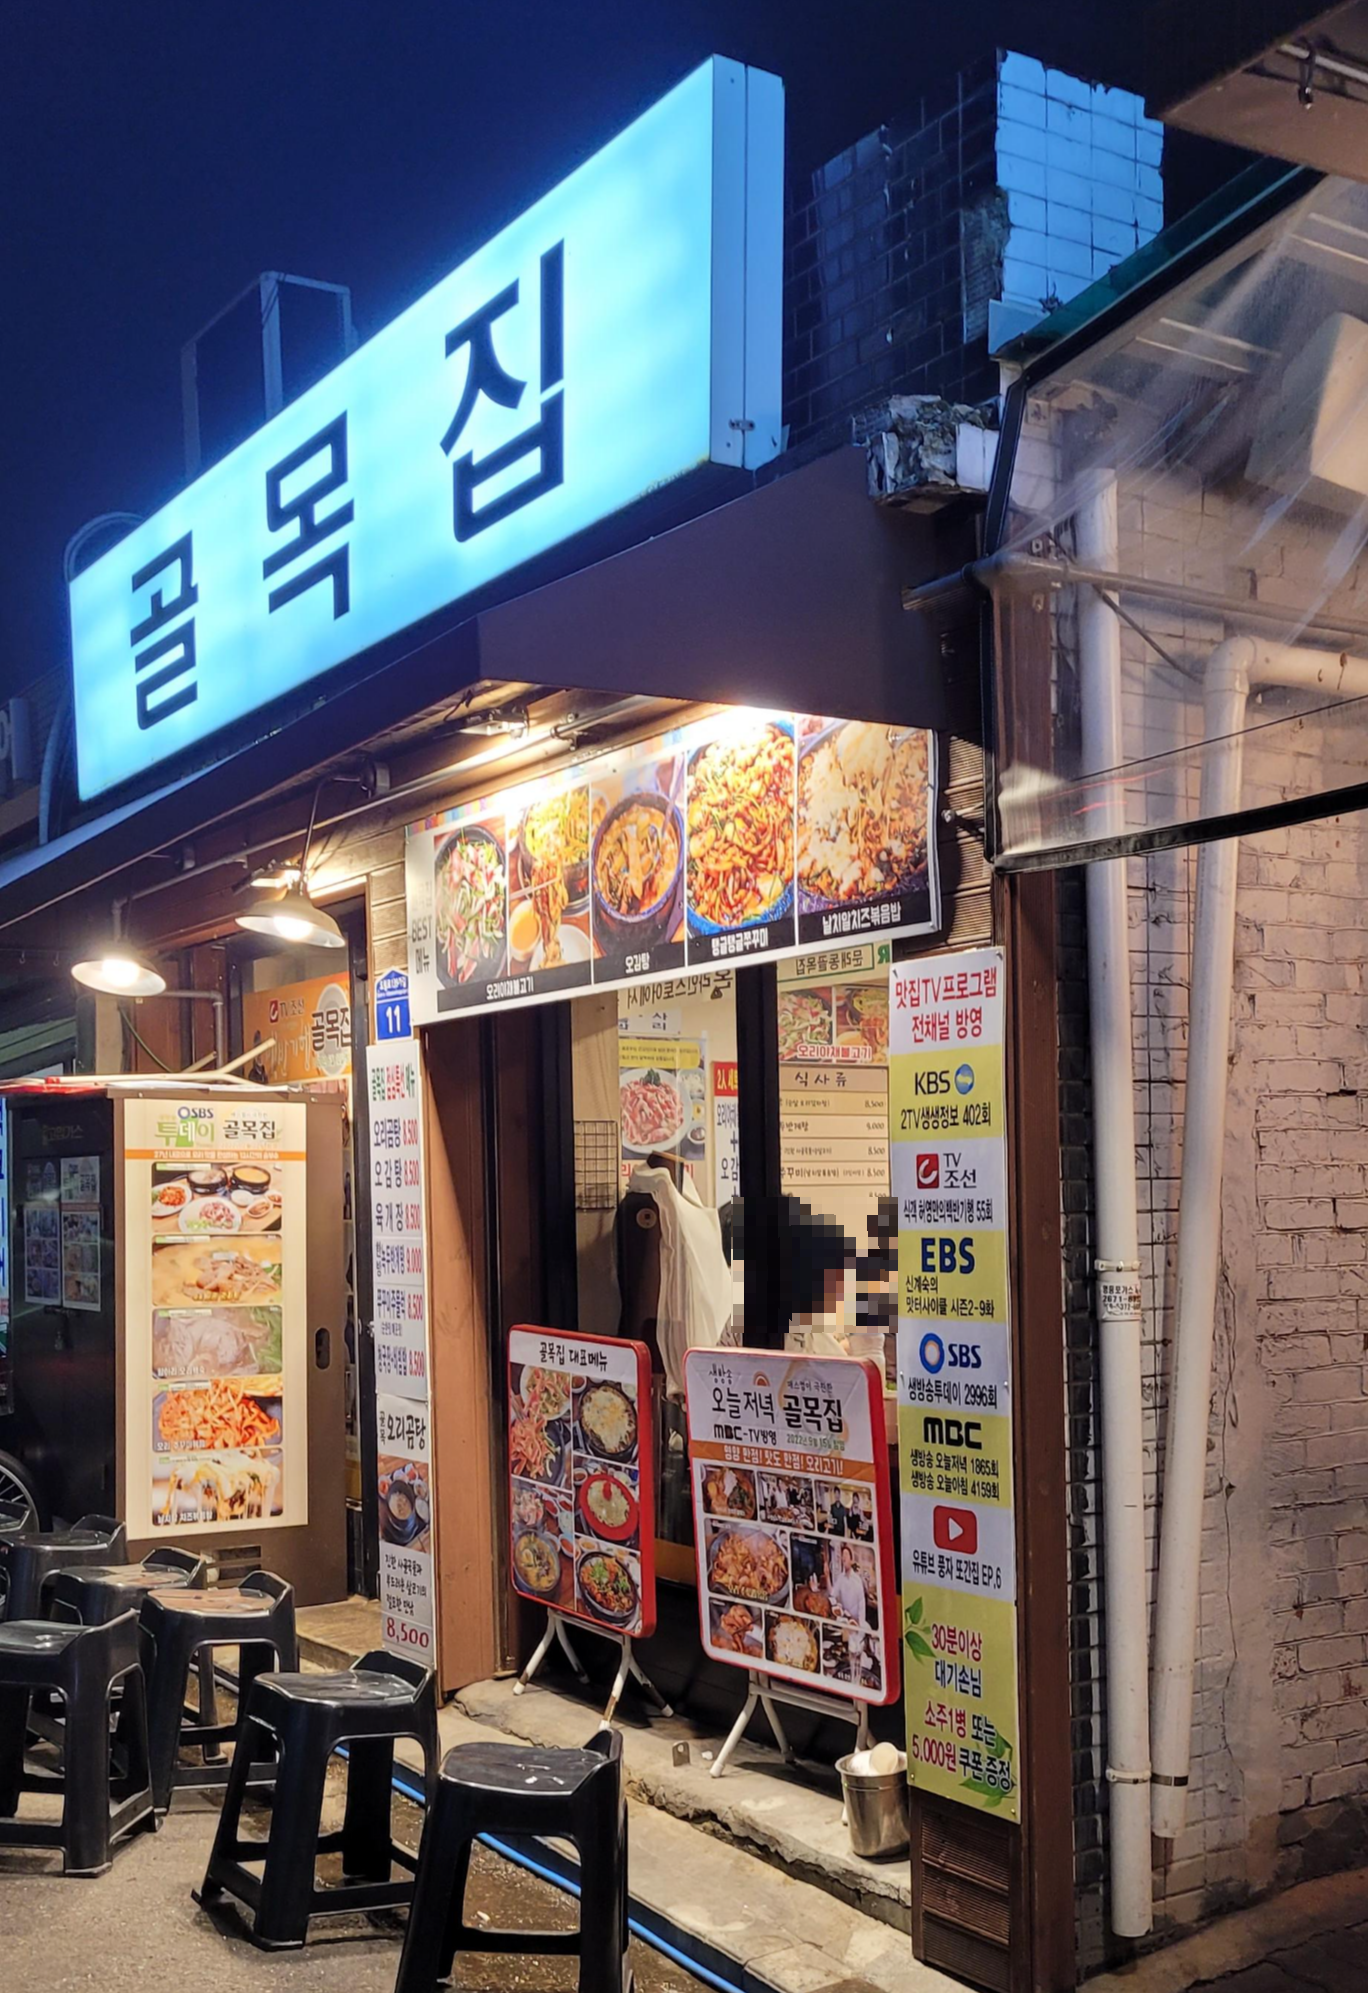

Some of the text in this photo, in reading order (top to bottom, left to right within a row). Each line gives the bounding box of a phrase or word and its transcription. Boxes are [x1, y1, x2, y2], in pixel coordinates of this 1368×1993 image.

[130, 237, 565, 732] 골목집
[412, 915, 432, 943] BEST
[415, 947, 430, 974] 메뉴
[895, 967, 998, 1010] 맛집TV프로그램
[386, 1005, 400, 1033] 11
[911, 1006, 982, 1043] 전채널 방영
[914, 1071, 950, 1095] KBS
[190, 1107, 215, 1119] SBS
[900, 1102, 992, 1130] 2TV생생정보 402회
[154, 1119, 277, 1148] 투데이 골목집
[374, 1117, 401, 1149] 오리곰탕
[943, 1153, 962, 1167] TV
[943, 1169, 977, 1189] 조선
[976, 1198, 993, 1223] 55회
[920, 1237, 976, 1275] EBS
[905, 1275, 938, 1294] 신계숙의
[950, 1298, 994, 1319] 시즌2-9화
[539, 1341, 608, 1372] 골목집 대표메뉴
[947, 1343, 982, 1369] SBS
[711, 1387, 843, 1434] 오늘저녁 골목집
[964, 1382, 998, 1410] 2996회
[387, 1413, 427, 1450] 오리곰탕
[923, 1416, 982, 1450] MBC
[743, 1446, 763, 1464] 만점!
[764, 1450, 782, 1467] 맛도
[783, 1452, 804, 1469] 만점!
[806, 1456, 844, 1476] 오리고기!
[910, 1448, 999, 1478] 생방송 오늘저녁 1865회
[911, 1470, 1000, 1501] 생방송 오늘아침 4159회
[912, 1549, 935, 1575] 유튜브
[937, 1554, 954, 1581] 풍자
[955, 1559, 980, 1586] 또간집
[386, 1616, 430, 1649] 8,500
[931, 1623, 982, 1662] 30분이상
[934, 1659, 982, 1699] 대기손님
[924, 1700, 997, 1747] 소주1병 또는
[912, 1734, 957, 1773] 5.000원
